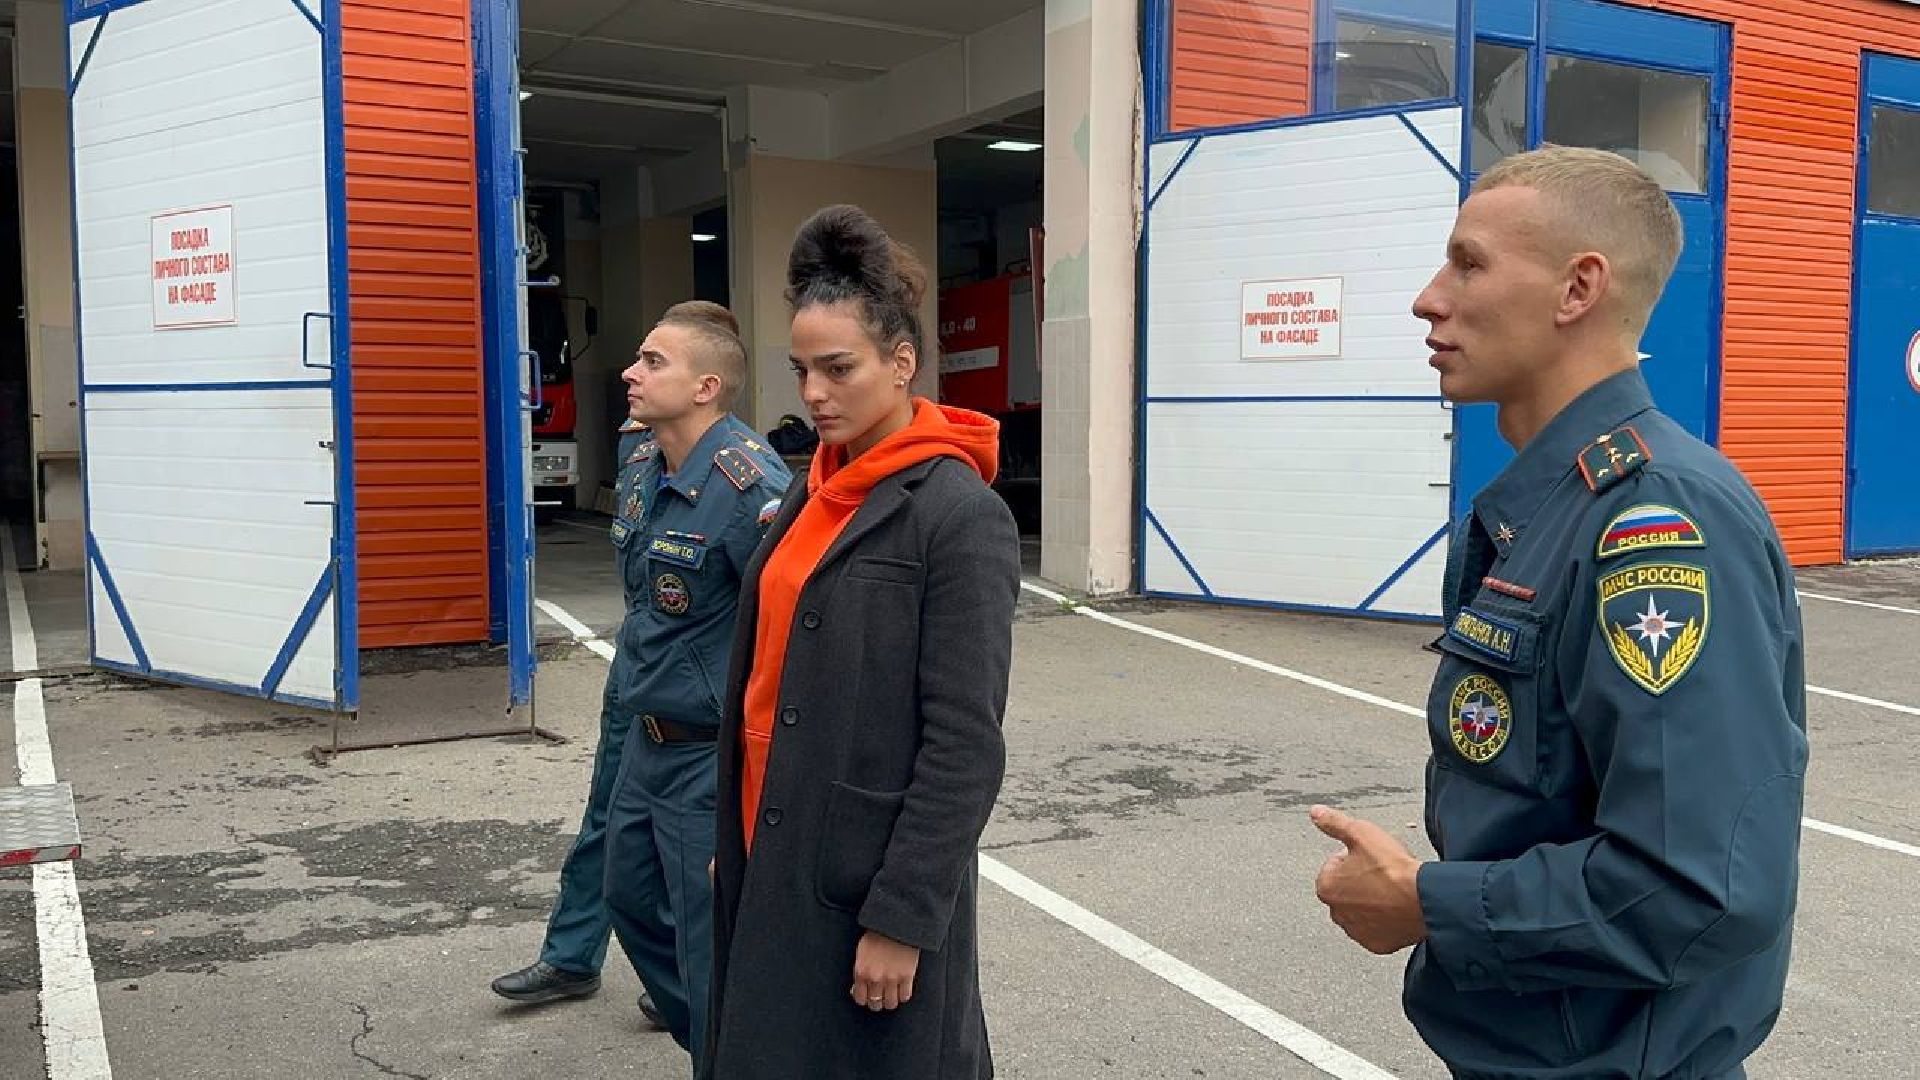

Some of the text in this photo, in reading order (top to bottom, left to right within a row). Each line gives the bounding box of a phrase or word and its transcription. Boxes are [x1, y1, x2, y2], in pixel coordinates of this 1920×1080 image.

[171, 227, 209, 250] ПОСАДКА
[154, 253, 230, 279] ЛИЧНОГО СОСТАВА
[168, 281, 217, 305] НА ФАСАДЕ
[1266, 291, 1315, 307] ПОСАДКА
[1245, 308, 1339, 327] ЛИЧНОГО СОСТАВА
[1260, 328, 1320, 345] НА ФАСАДЕ
[1618, 531, 1679, 548] РОССИЯ
[1604, 568, 1703, 596] МЧС РОССИИ
[1454, 678, 1509, 719] МЧС РОССИИ
